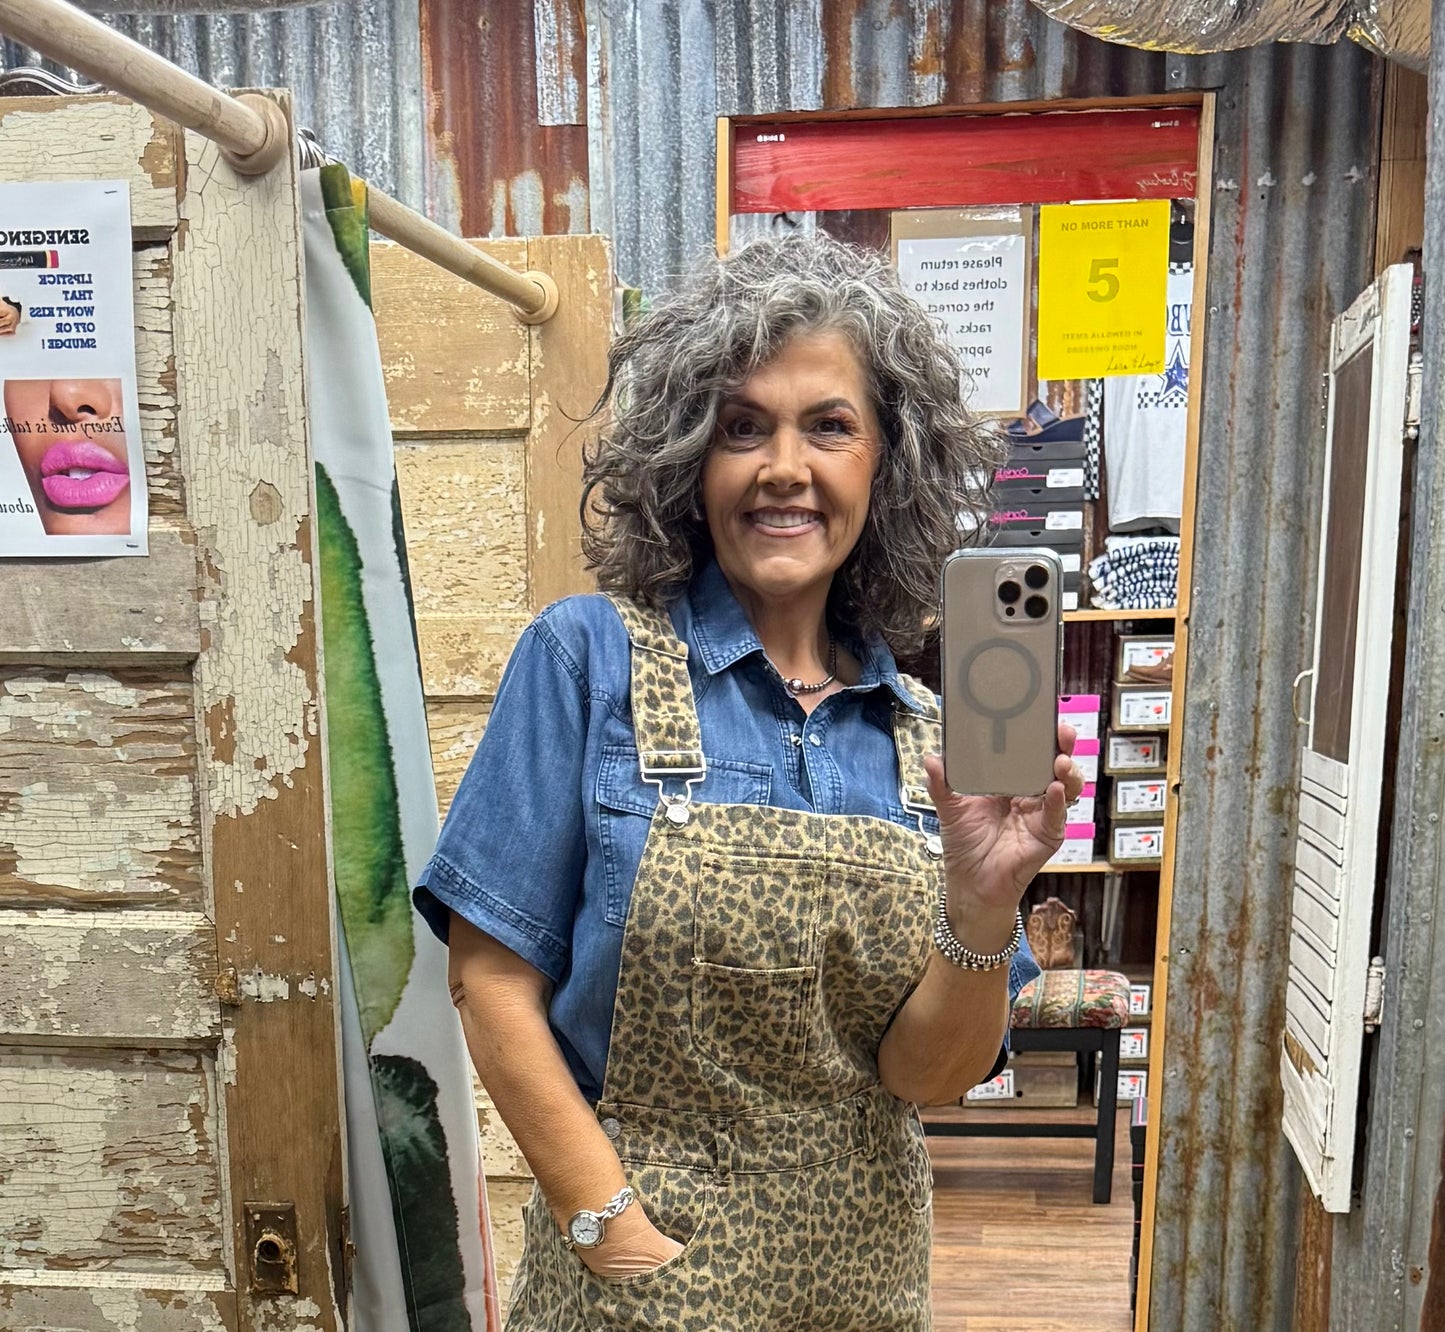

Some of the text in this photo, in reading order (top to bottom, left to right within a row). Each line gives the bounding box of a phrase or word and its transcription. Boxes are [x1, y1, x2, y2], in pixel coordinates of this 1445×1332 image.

[1061, 219, 1149, 231] NO MORE THAN
[1086, 258, 1120, 303] 5
